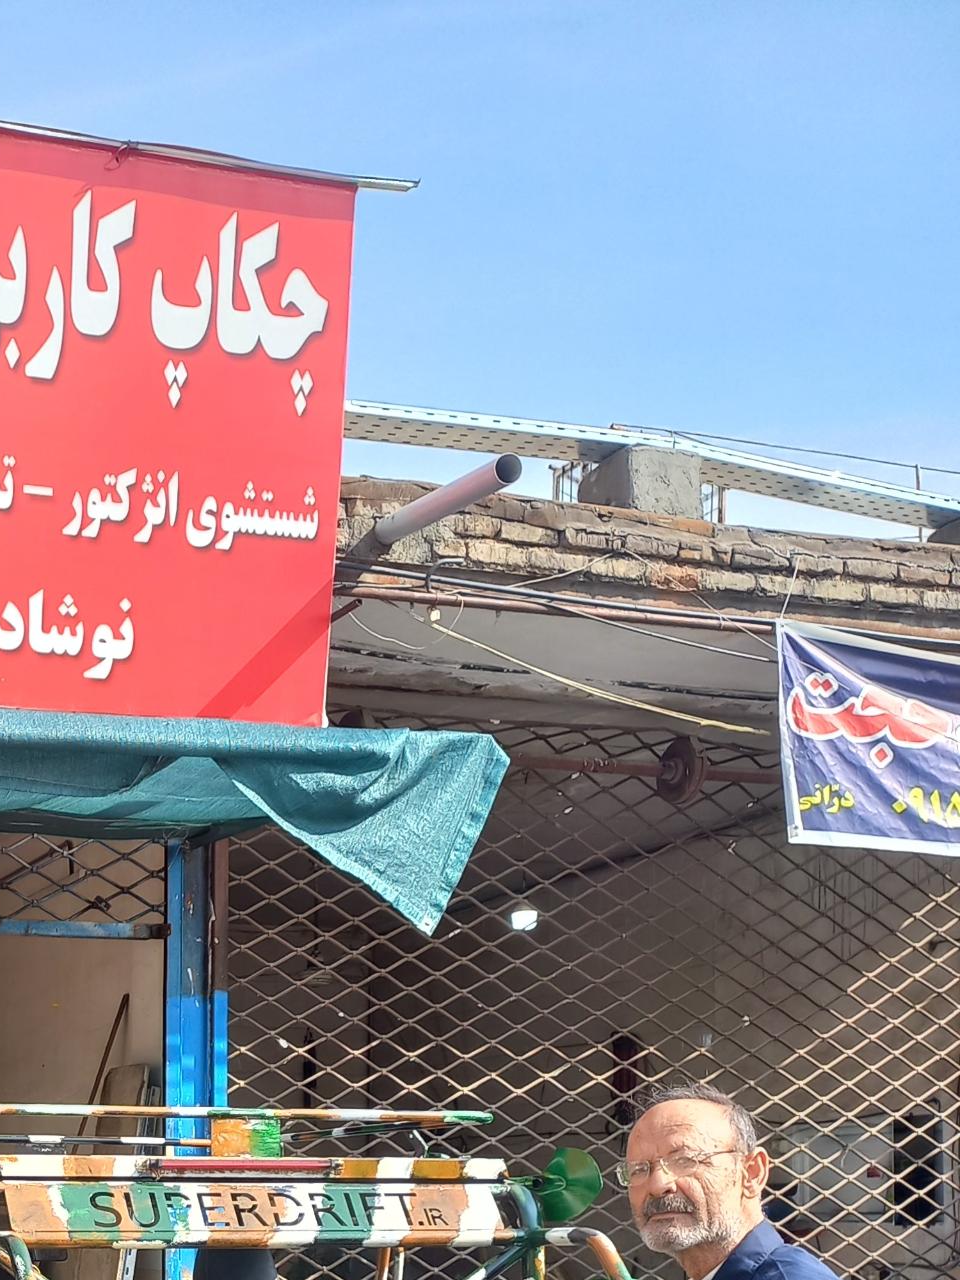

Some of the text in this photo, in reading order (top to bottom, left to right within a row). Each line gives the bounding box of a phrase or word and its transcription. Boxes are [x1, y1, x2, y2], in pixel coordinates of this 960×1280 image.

[152, 212, 329, 417] چکاپ
[62, 468, 179, 543] انژکتور
[186, 481, 320, 551] شستشوی
